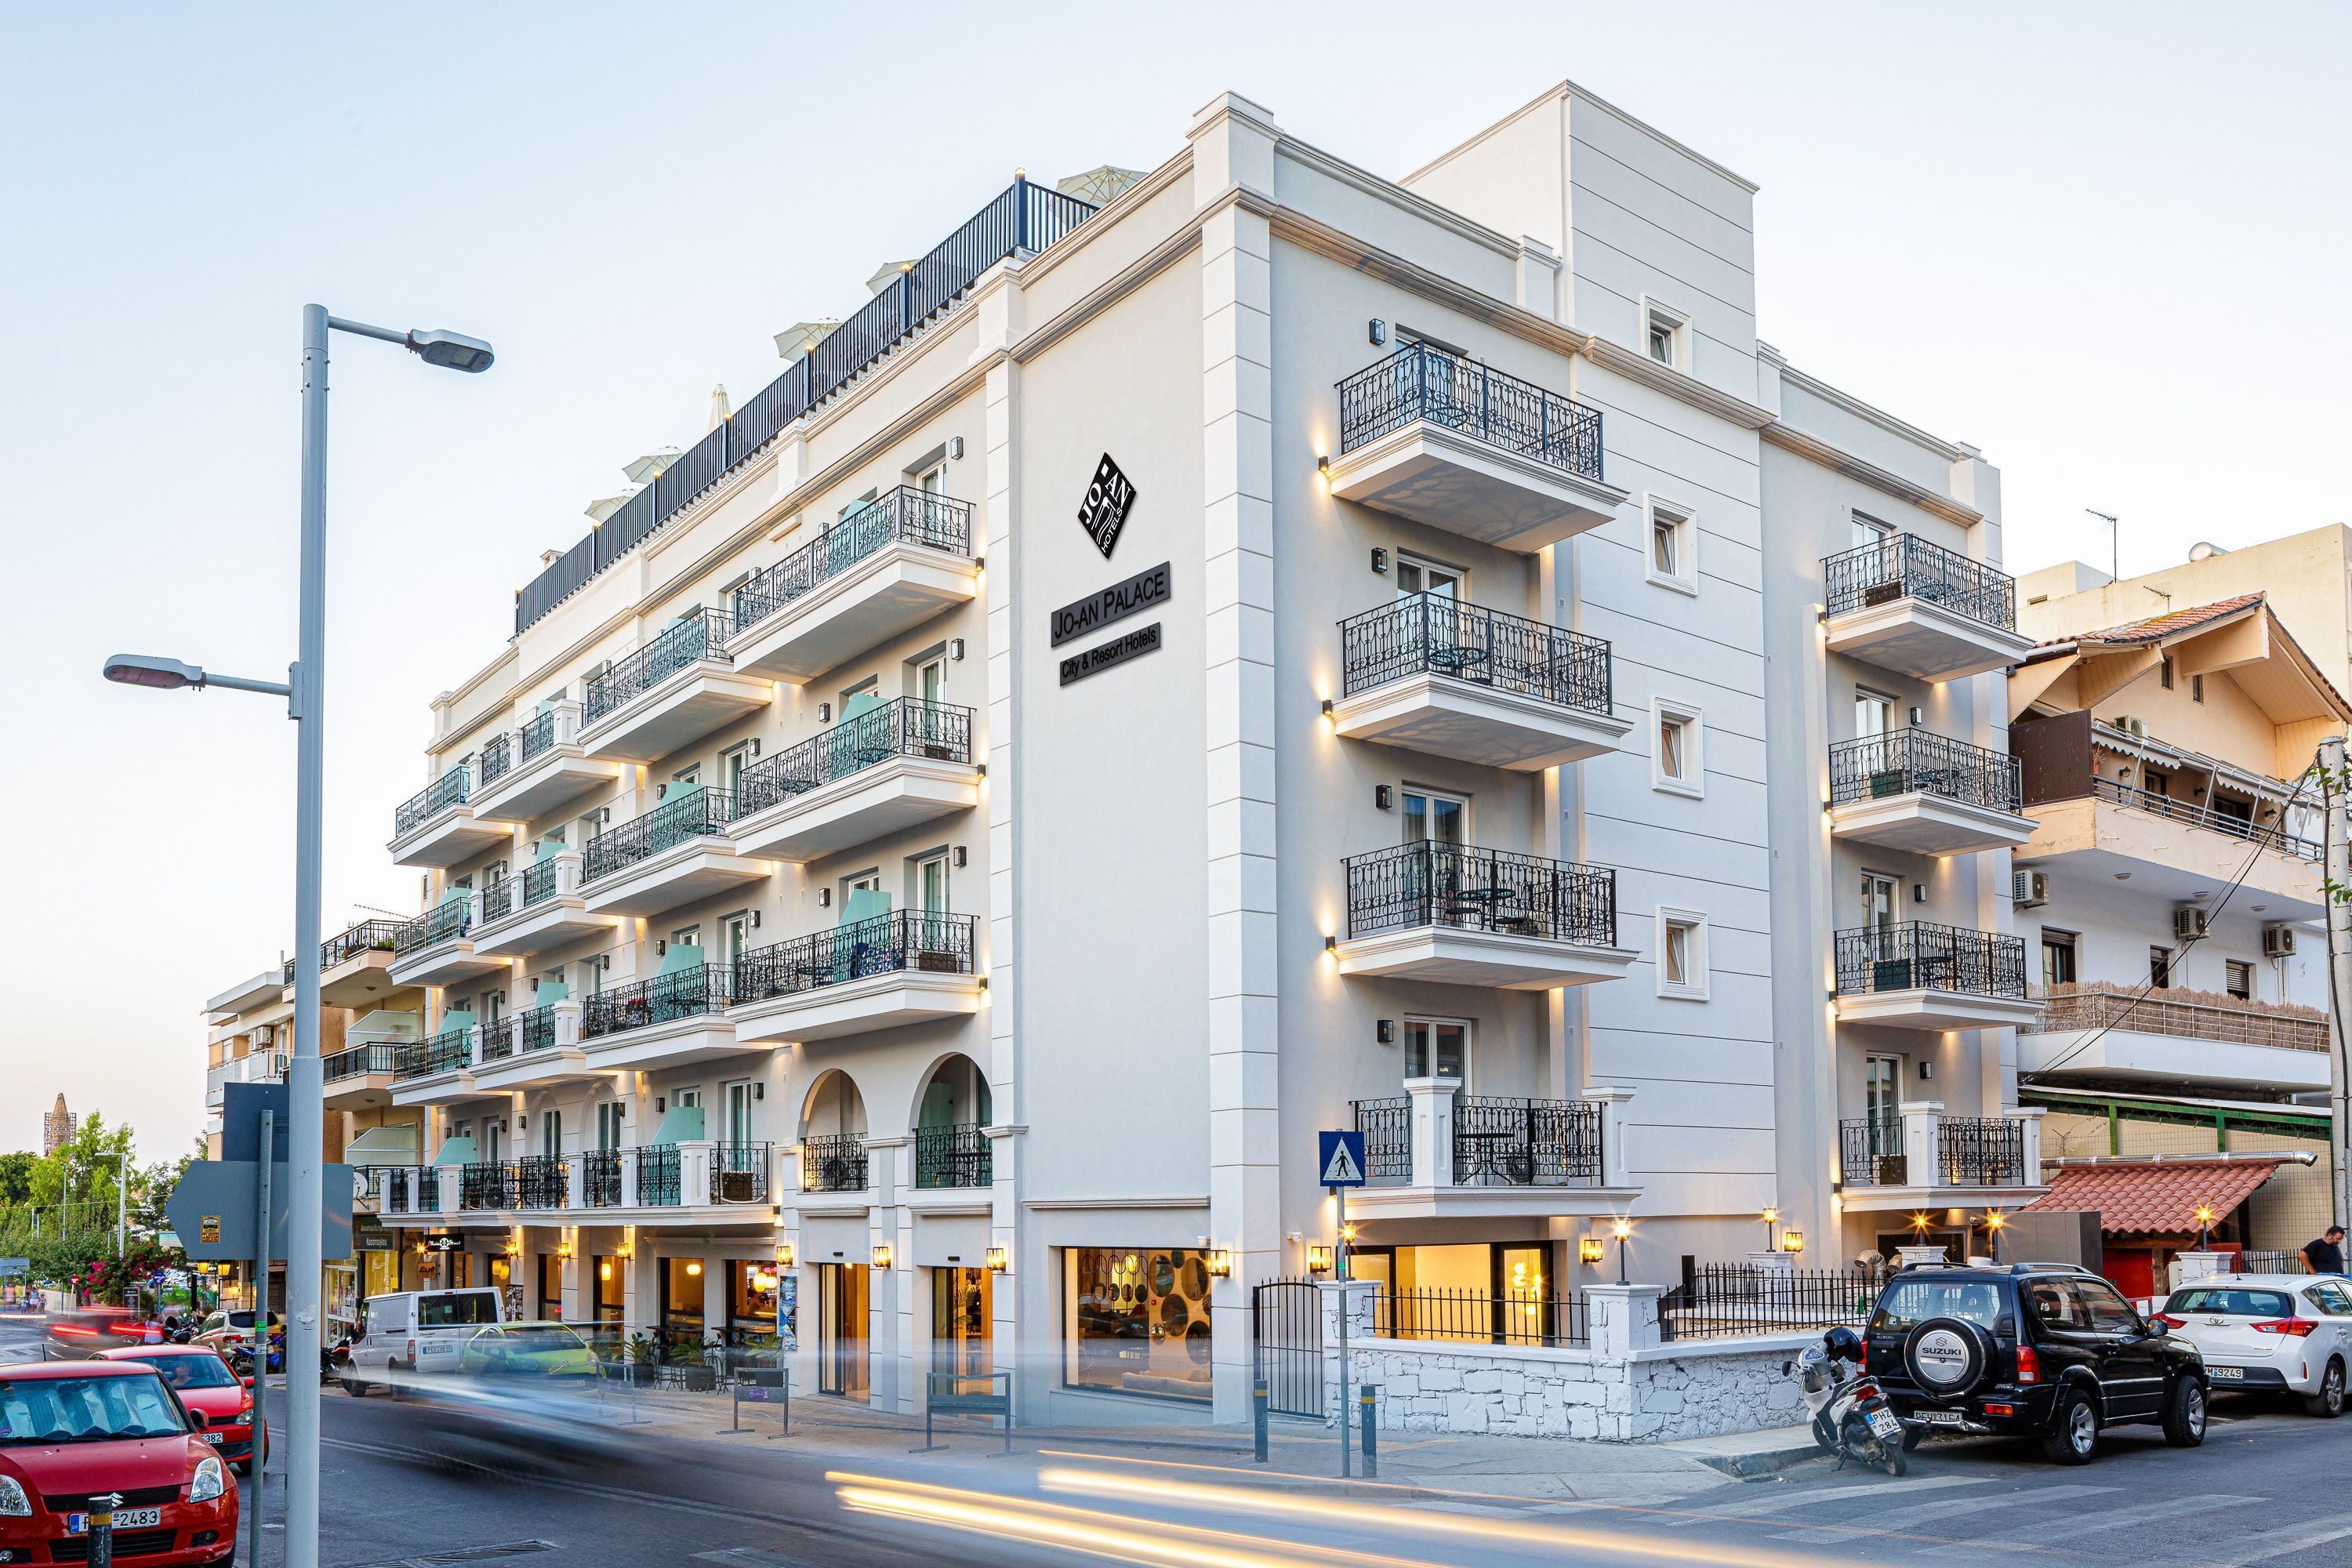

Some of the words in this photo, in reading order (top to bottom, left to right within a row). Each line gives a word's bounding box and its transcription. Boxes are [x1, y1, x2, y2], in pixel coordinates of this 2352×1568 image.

[1102, 507, 1123, 553] HOTELS
[1055, 601, 1098, 639] JO-AN
[1104, 572, 1165, 619] PALACE
[1062, 659, 1080, 677] City
[1092, 639, 1123, 666] Resort
[1125, 628, 1156, 653] Hotels
[1873, 1410, 1892, 1422] PHZ
[1878, 1420, 1897, 1432] 284
